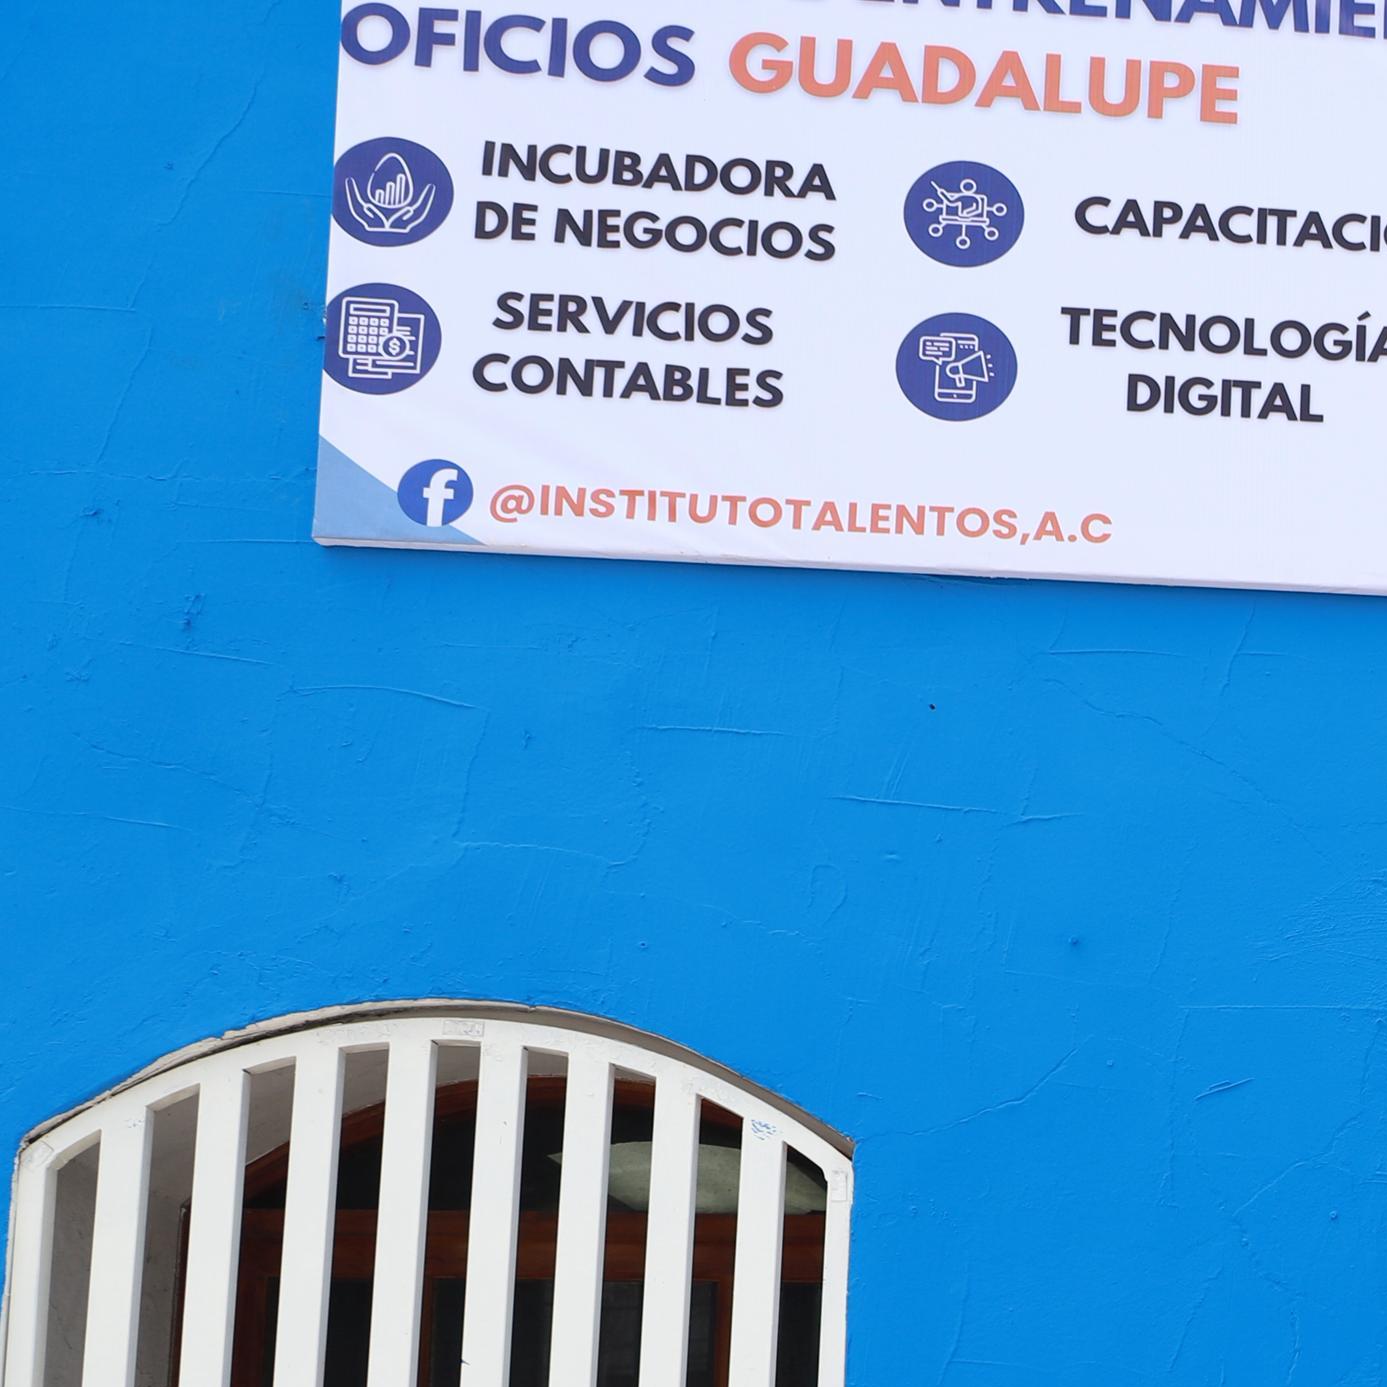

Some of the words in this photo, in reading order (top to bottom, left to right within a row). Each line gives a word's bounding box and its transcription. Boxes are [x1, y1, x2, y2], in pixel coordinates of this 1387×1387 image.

[341, 2, 695, 87] OFICIOS
[729, 32, 1239, 124] GUADALUPE
[482, 140, 836, 201] INCUBADORA
[474, 201, 538, 241] DE
[554, 208, 835, 262] NEGOCIOS
[492, 291, 773, 345] SERVICIOS
[472, 353, 783, 408] CONTABLES
[1127, 373, 1324, 423] DIGITAL
[490, 485, 1112, 545] @INSTITUTOTALENTOS,A.C
